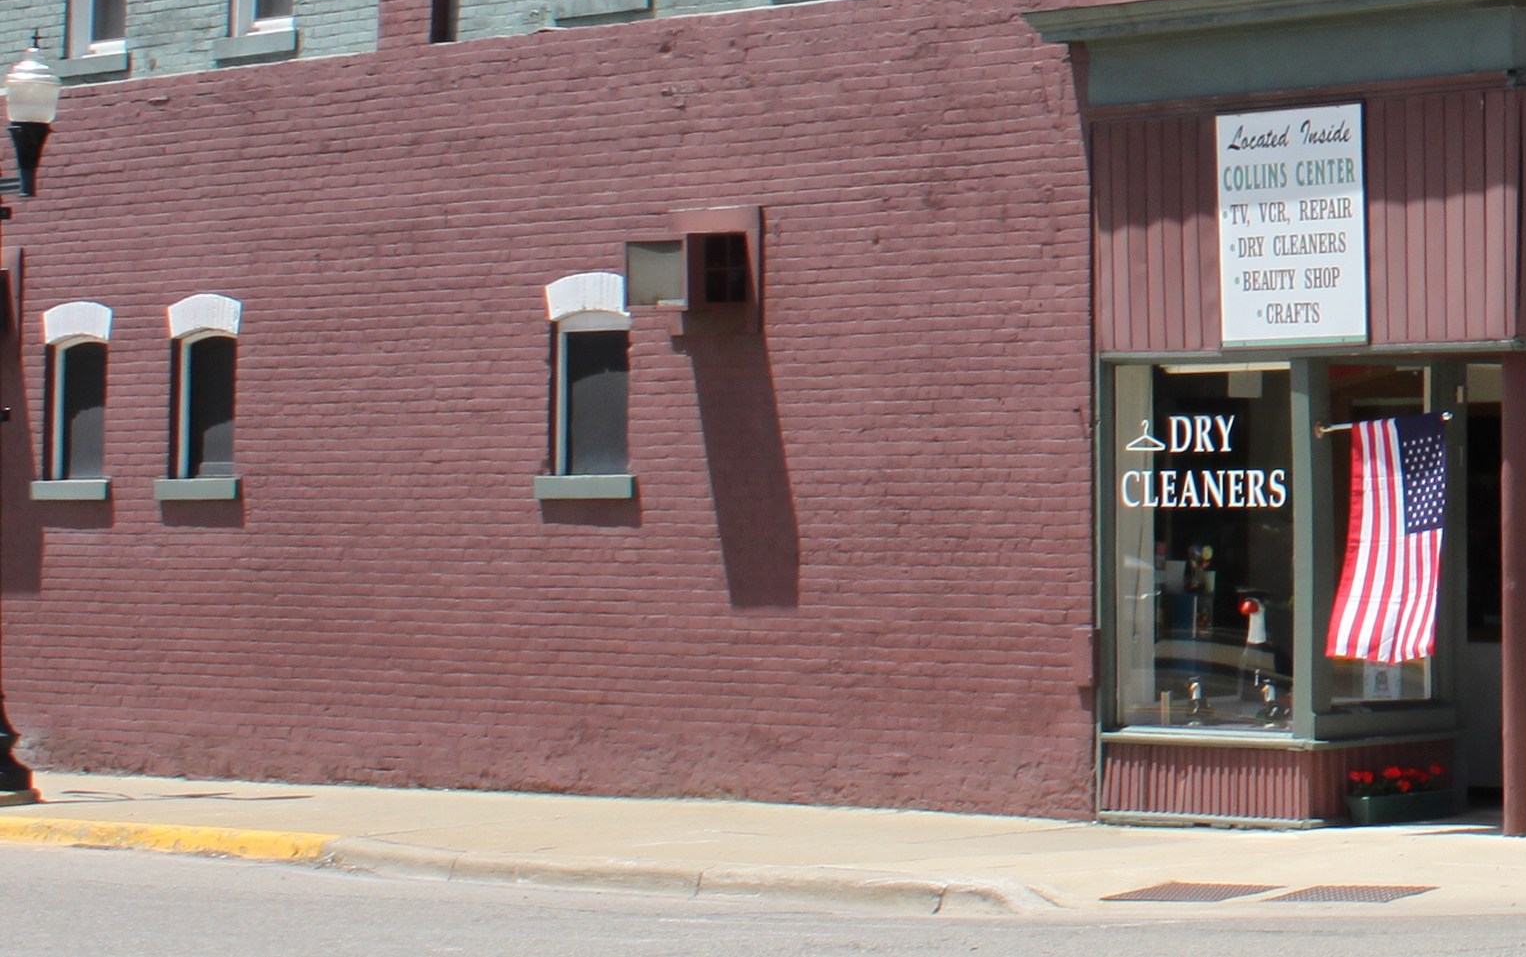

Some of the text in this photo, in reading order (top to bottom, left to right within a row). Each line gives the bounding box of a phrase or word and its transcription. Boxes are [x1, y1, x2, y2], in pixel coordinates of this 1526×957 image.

[1227, 118, 1352, 151] Located Inside
[1222, 157, 1356, 192] COLLINS CENTER
[1258, 200, 1291, 226] VCR,
[1298, 196, 1353, 222] REPAIR
[1237, 231, 1347, 259] DRY CLEANERS
[1242, 265, 1341, 293] BEAUTY SHOP
[1265, 300, 1321, 325] CRAFTS
[1168, 414, 1236, 454] DRY
[1121, 468, 1288, 509] CLEANERS
